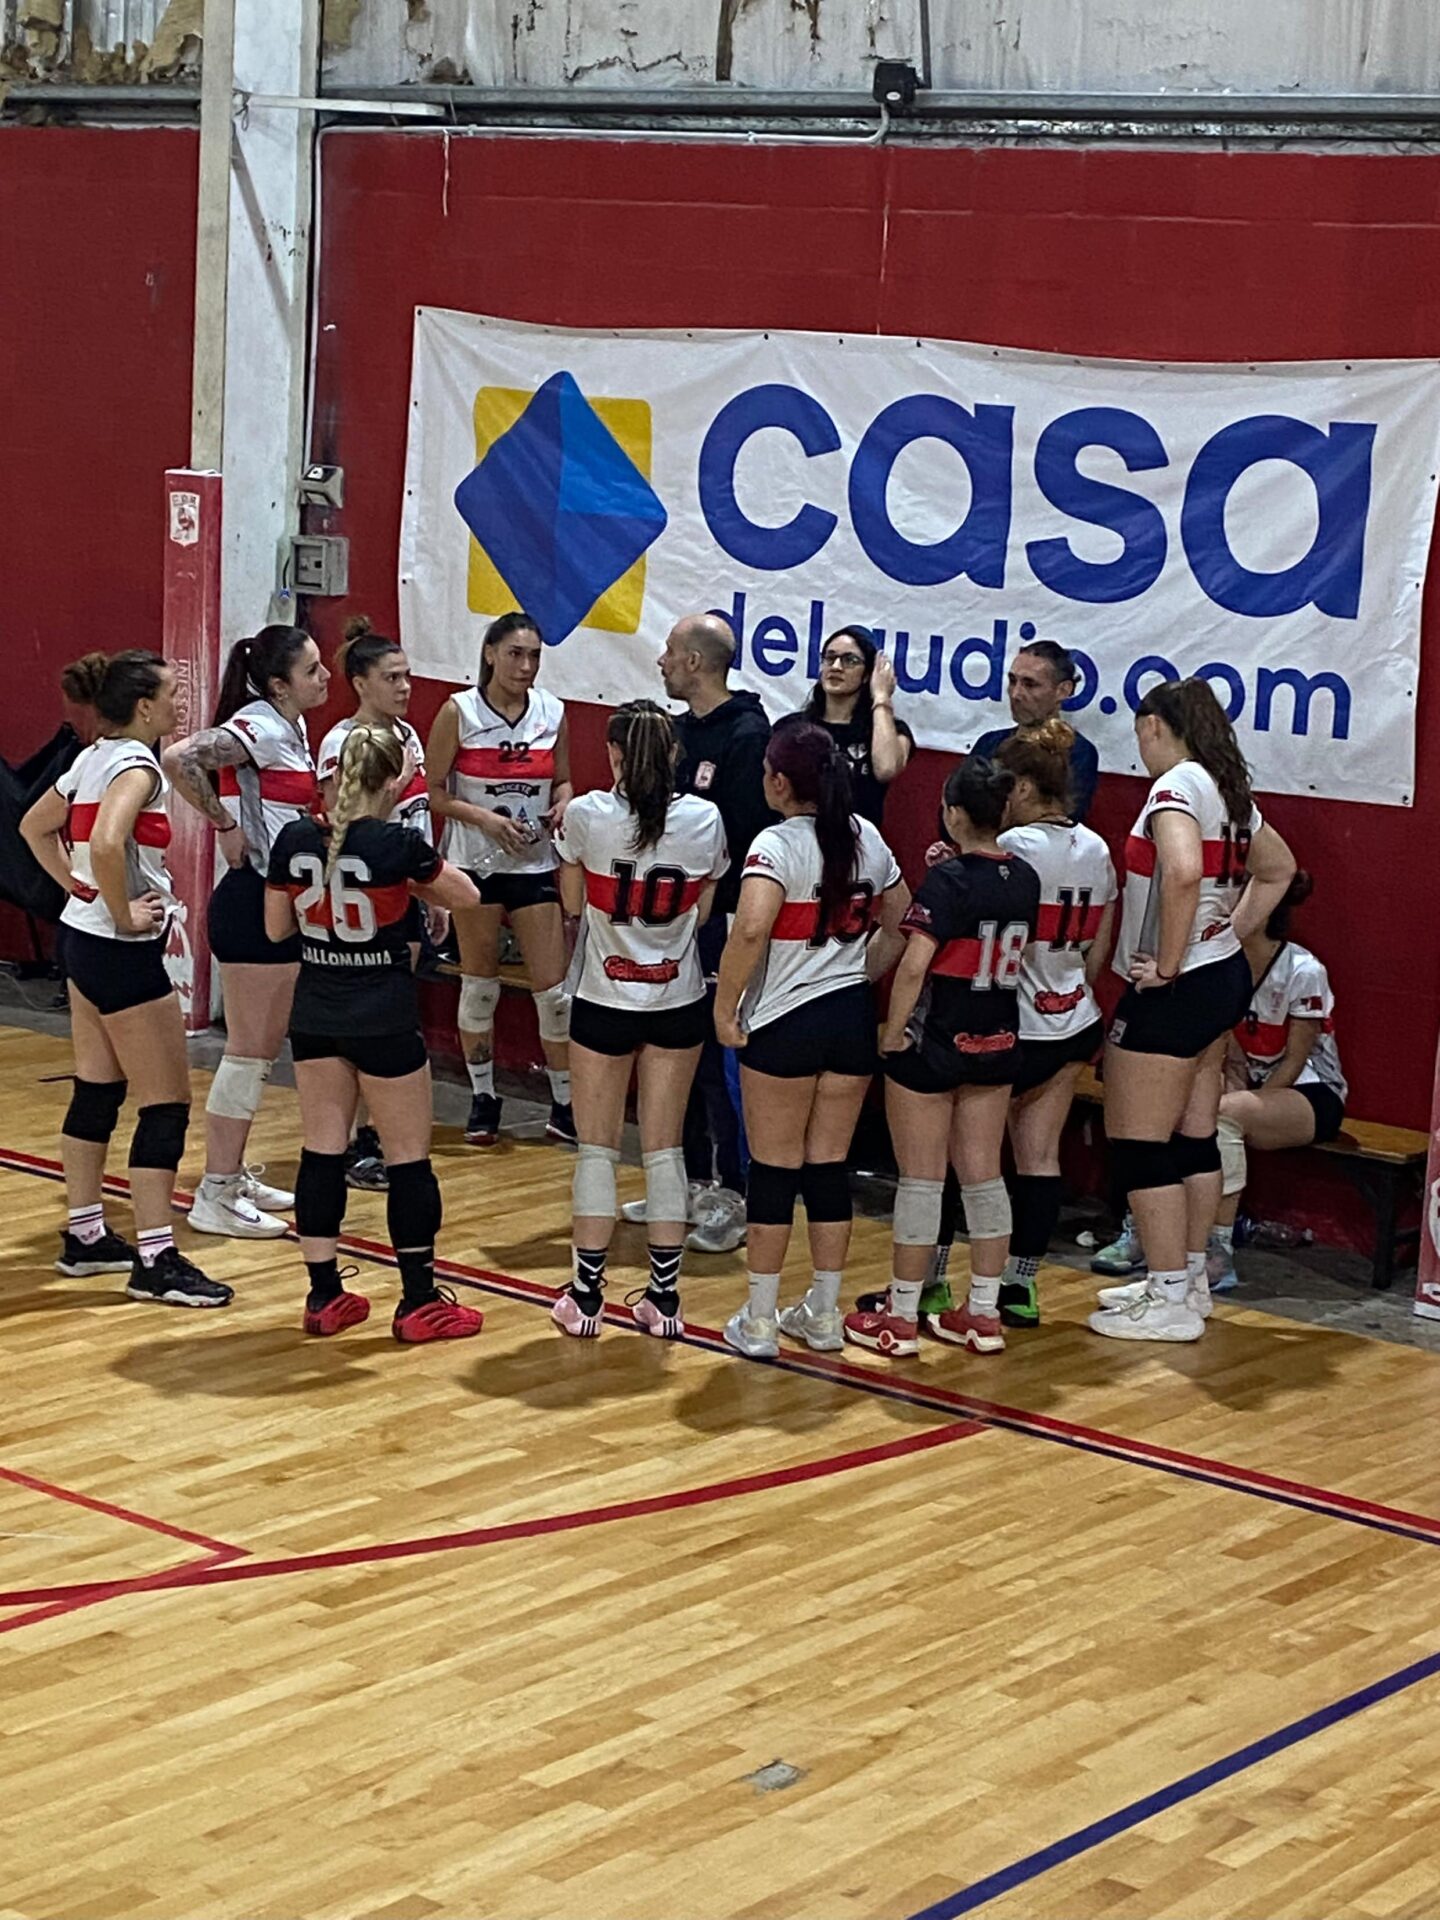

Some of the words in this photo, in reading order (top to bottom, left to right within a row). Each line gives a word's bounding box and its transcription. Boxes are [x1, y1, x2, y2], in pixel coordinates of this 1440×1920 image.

[698, 383, 1377, 620] casa
[703, 591, 1352, 740] deludo.com
[499, 740, 532, 763] 22
[290, 853, 377, 942] 26
[610, 859, 689, 927] 10
[1048, 886, 1092, 951] 11
[971, 920, 1028, 991] 18
